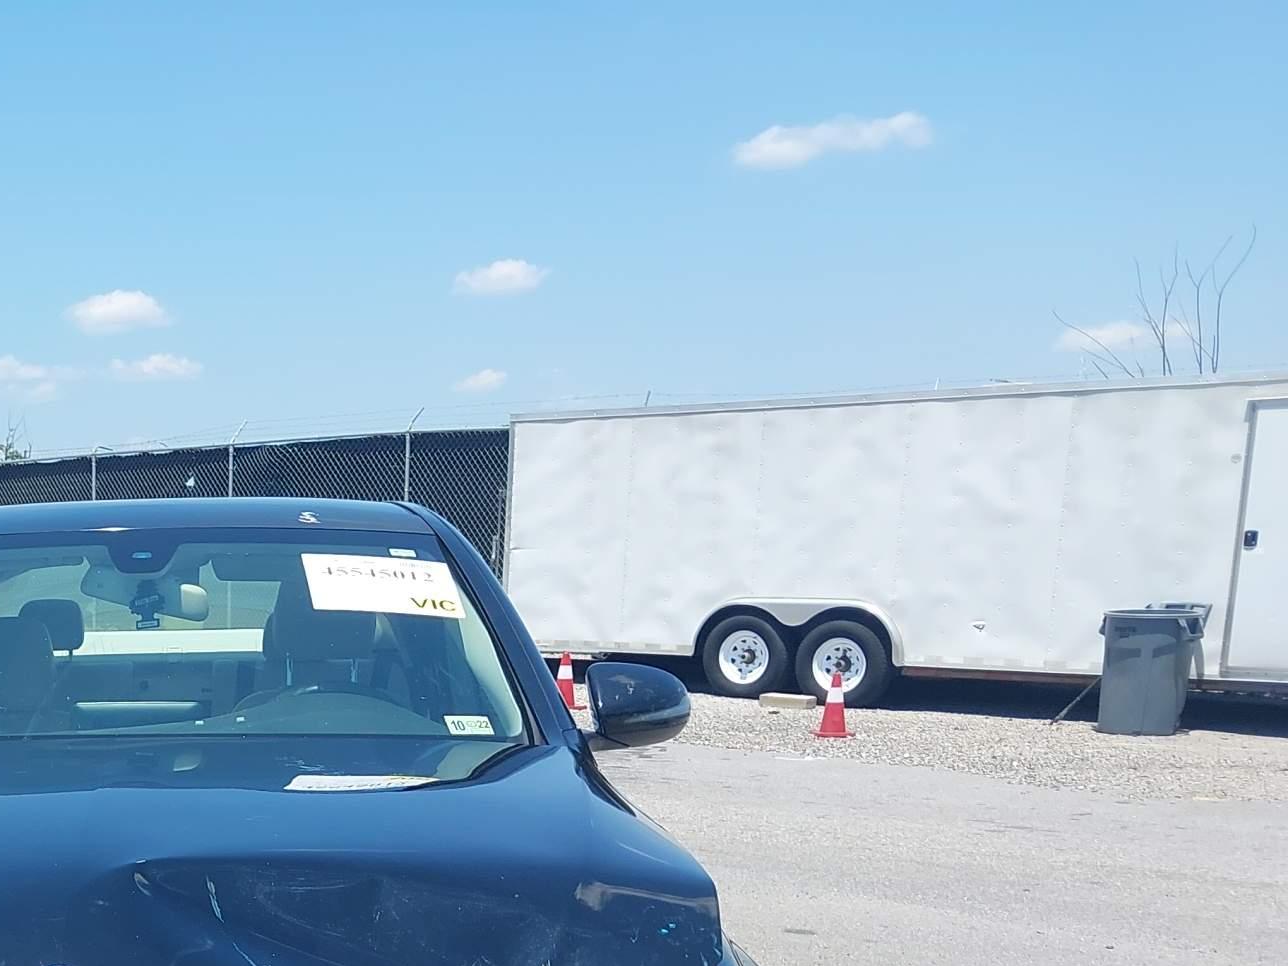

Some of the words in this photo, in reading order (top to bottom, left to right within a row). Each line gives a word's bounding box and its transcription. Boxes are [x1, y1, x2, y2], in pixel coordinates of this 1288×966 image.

[410, 597, 457, 612] VIC
[451, 720, 465, 731] 10
[476, 720, 491, 729] 22
